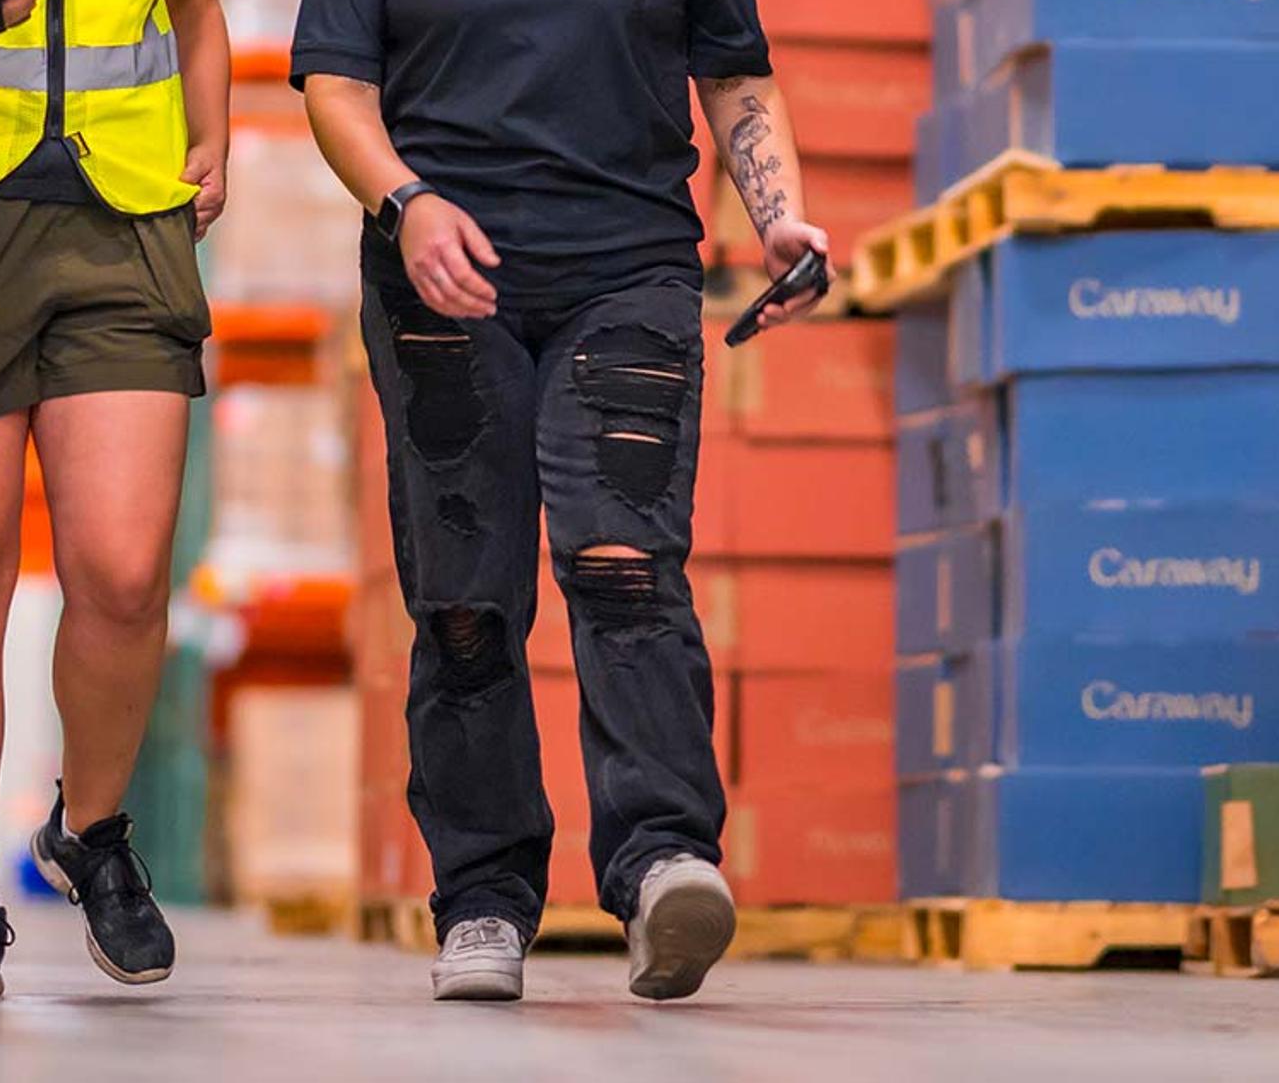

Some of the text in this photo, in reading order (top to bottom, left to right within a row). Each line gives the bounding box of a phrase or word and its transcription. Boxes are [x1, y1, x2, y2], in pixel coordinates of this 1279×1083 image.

[1068, 277, 1242, 325] Caraway
[1087, 546, 1262, 596] Caraway
[1080, 679, 1255, 730] Caraway
